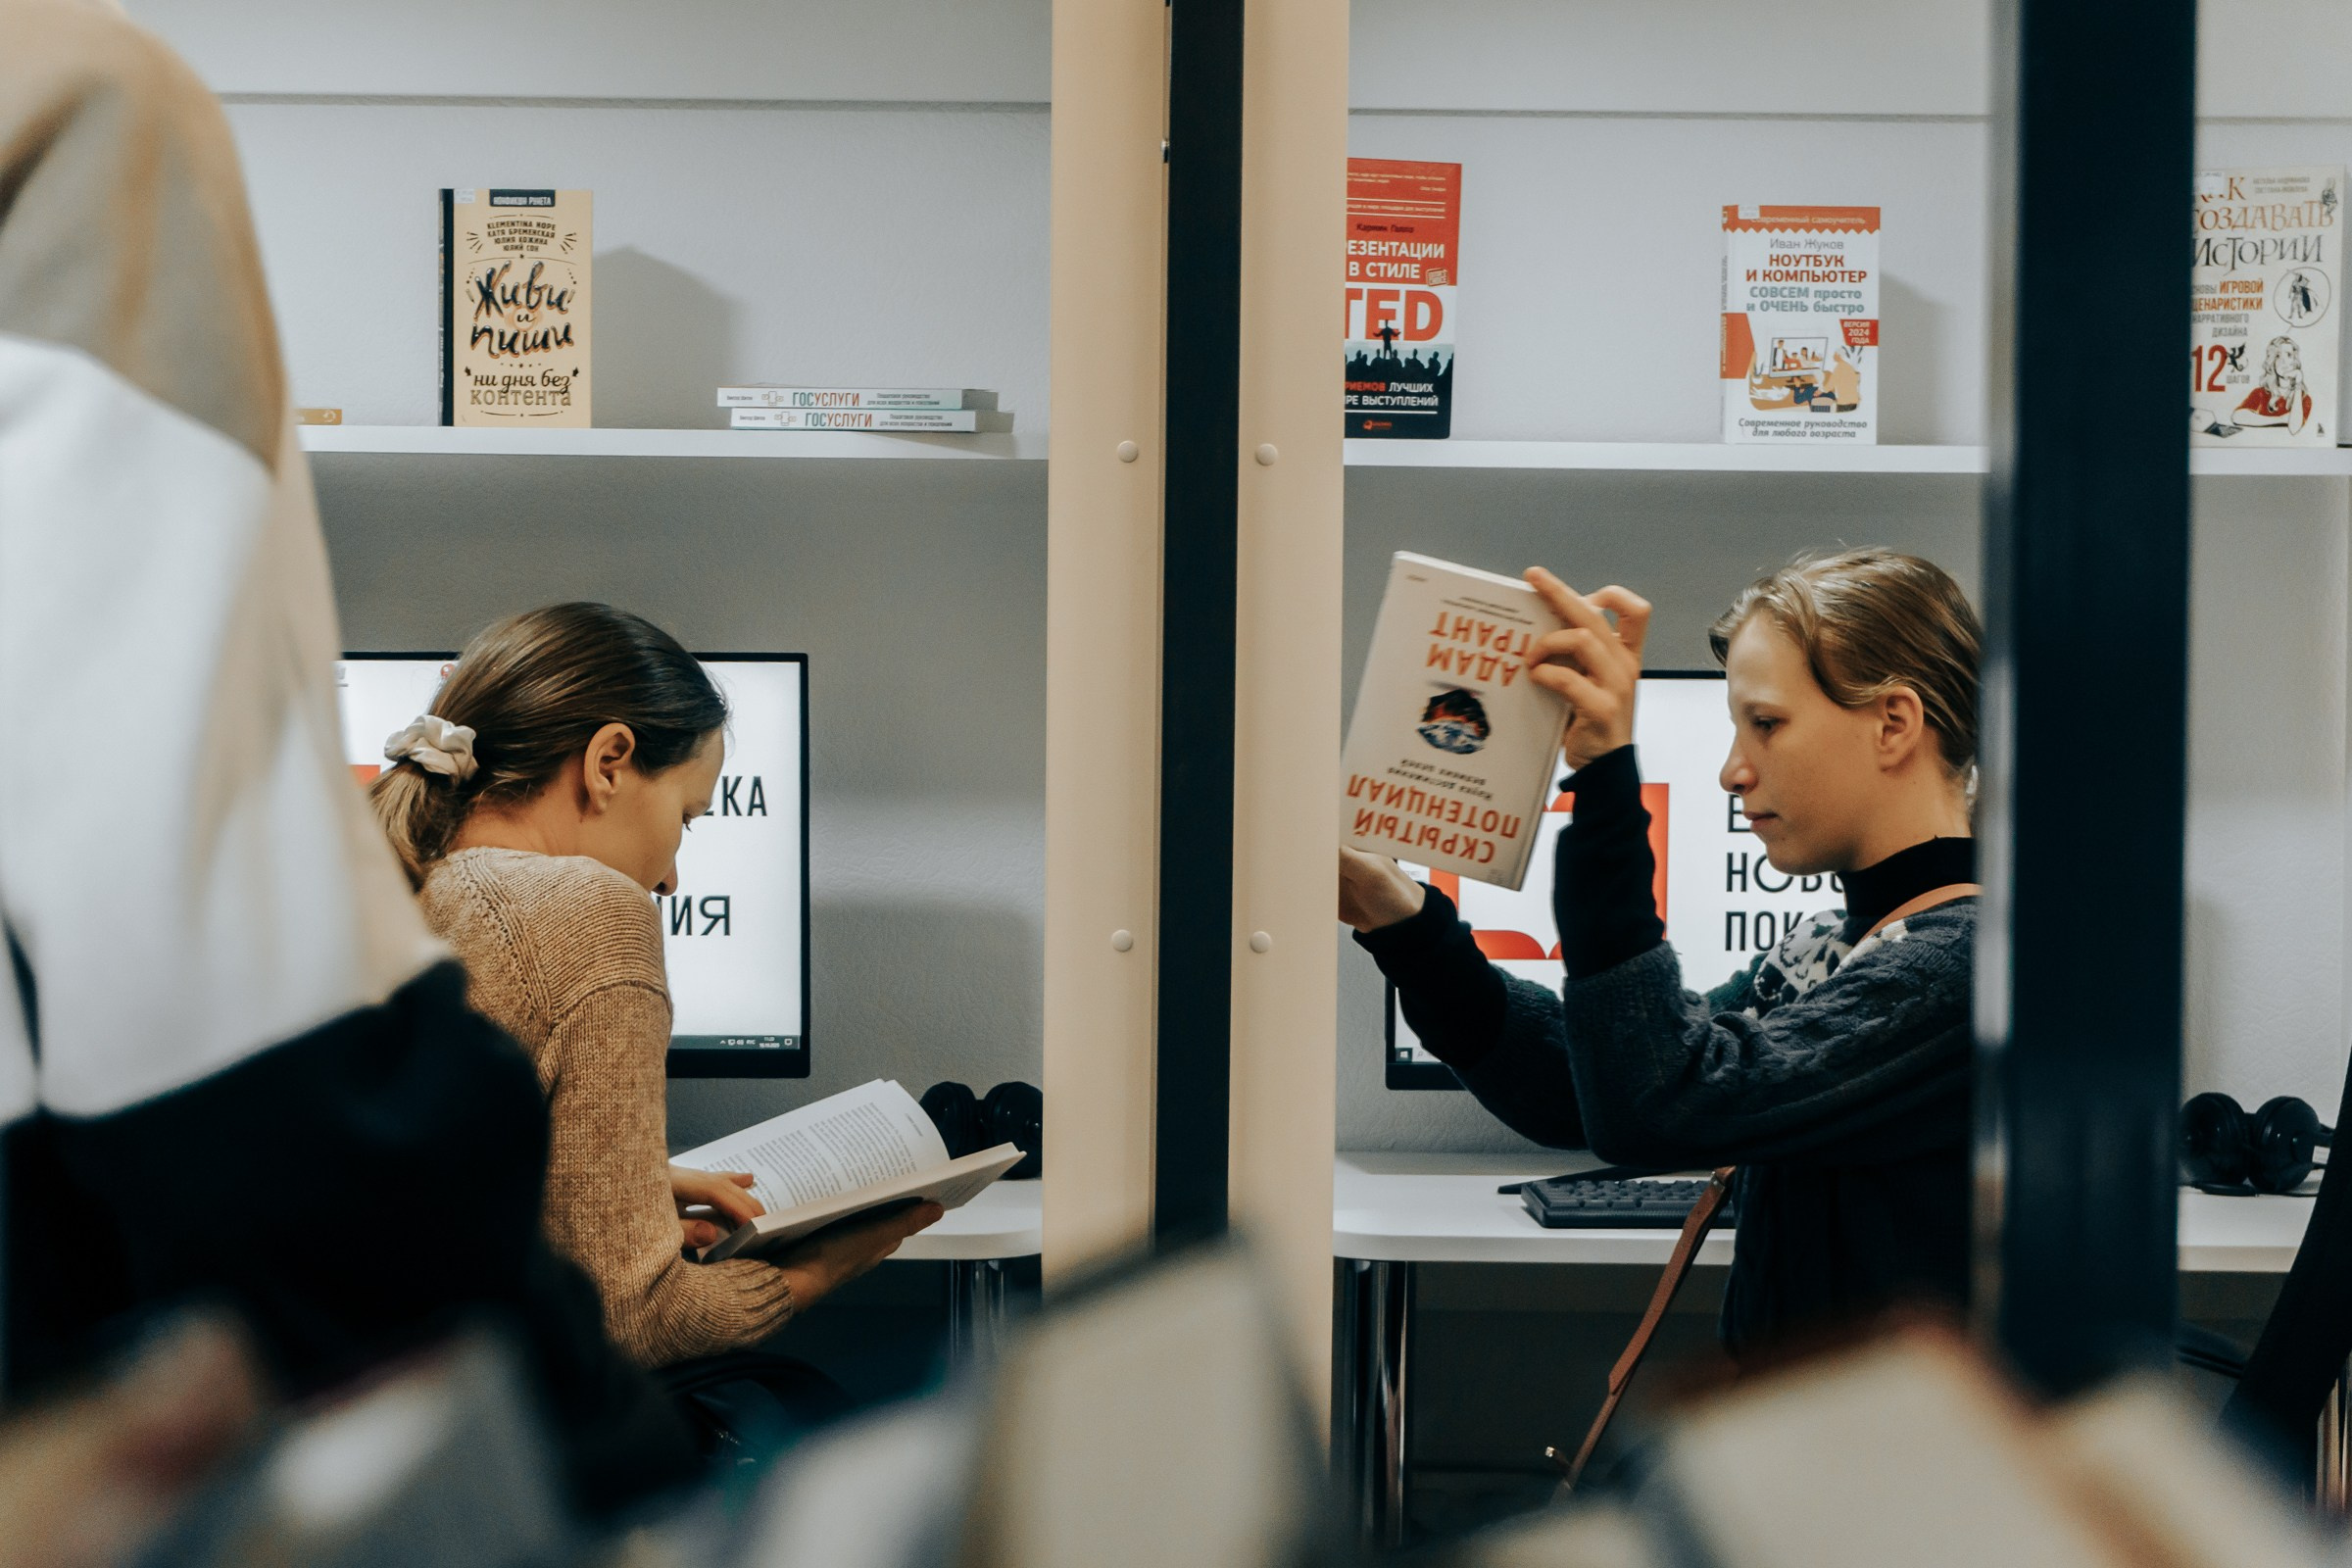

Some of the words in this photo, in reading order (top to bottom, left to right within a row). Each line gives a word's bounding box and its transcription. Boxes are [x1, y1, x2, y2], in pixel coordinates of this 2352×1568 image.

[2193, 200, 2334, 232] ОЗДАВАТЬ
[1770, 238, 1800, 249] Иван
[1804, 239, 1844, 252] Жуков
[1769, 254, 1844, 268] НОУТБУК
[1348, 262, 1360, 277] В
[1366, 262, 1421, 279] СТИЛЕ
[1746, 270, 1757, 282] И
[1762, 270, 1867, 283] КОМПЬЮТЕР
[473, 260, 569, 321] Живи
[1749, 286, 1809, 299] СОВСЕМ
[1813, 289, 1862, 302] просто
[2220, 278, 2264, 294] ИГРОВОЙ
[1746, 303, 1756, 312] и
[1759, 300, 1809, 313] ОЧЕНЬ
[1813, 301, 1864, 316] быстро
[516, 312, 535, 323] и
[1848, 328, 1870, 337] 2024
[2191, 345, 2228, 392] 12
[473, 373, 498, 387] ни
[501, 373, 535, 393] дня
[541, 368, 571, 394] без
[1389, 381, 1434, 393] ЛУЧШИХ
[792, 392, 859, 407] ГОСУСЛУГИ
[1362, 394, 1439, 406] ВЫСТУПЛЕНИЙ
[805, 413, 872, 427] ГОСУСЛУГИ
[1739, 417, 1801, 429] Современное
[1804, 419, 1867, 429] руководство
[1752, 427, 1770, 437] для
[1772, 428, 1807, 437] любого
[1809, 429, 1856, 438] возраста
[1430, 612, 1532, 657] ГРАНТ
[1427, 643, 1521, 687] АДАМ
[704, 775, 768, 816] КА
[1347, 774, 1521, 839] ПОТЕНЦИАЛ
[1353, 808, 1495, 863] СКРЫТЫЙ
